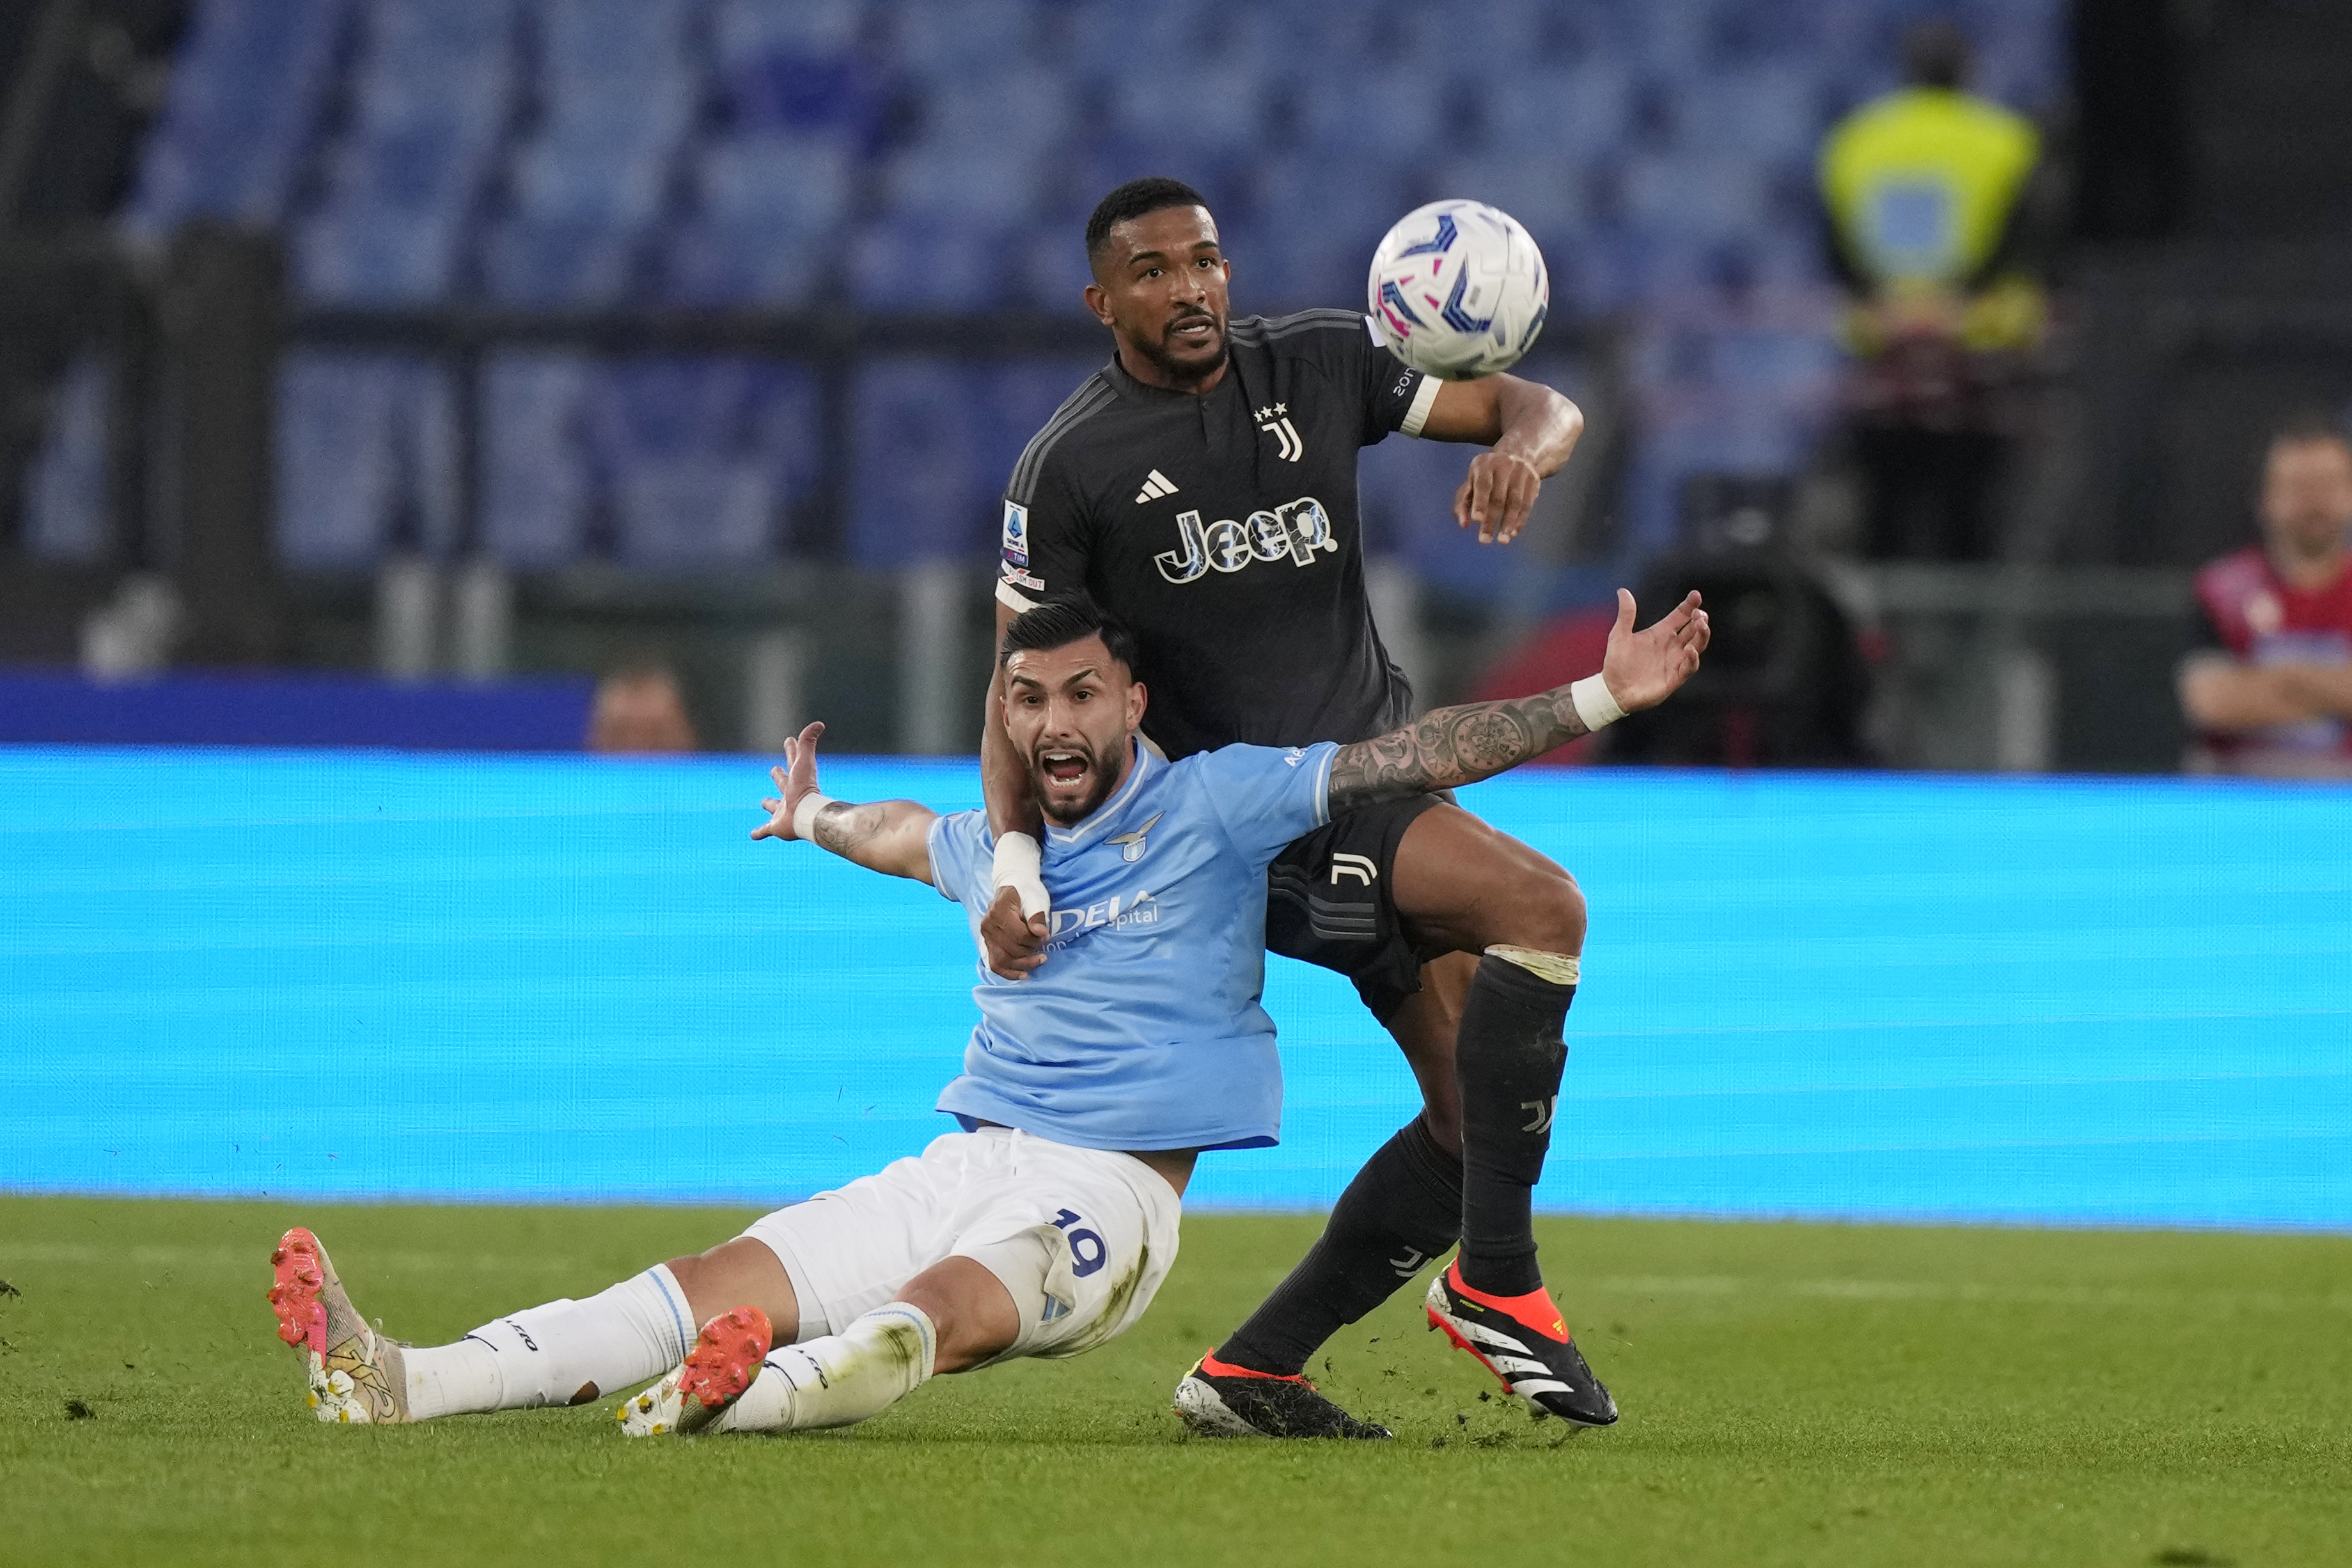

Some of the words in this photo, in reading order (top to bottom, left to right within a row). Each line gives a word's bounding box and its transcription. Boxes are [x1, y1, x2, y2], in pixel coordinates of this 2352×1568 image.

[1154, 496, 1331, 584] Jeep
[1014, 553, 1025, 563] TIM
[1028, 579, 1042, 588] OUT
